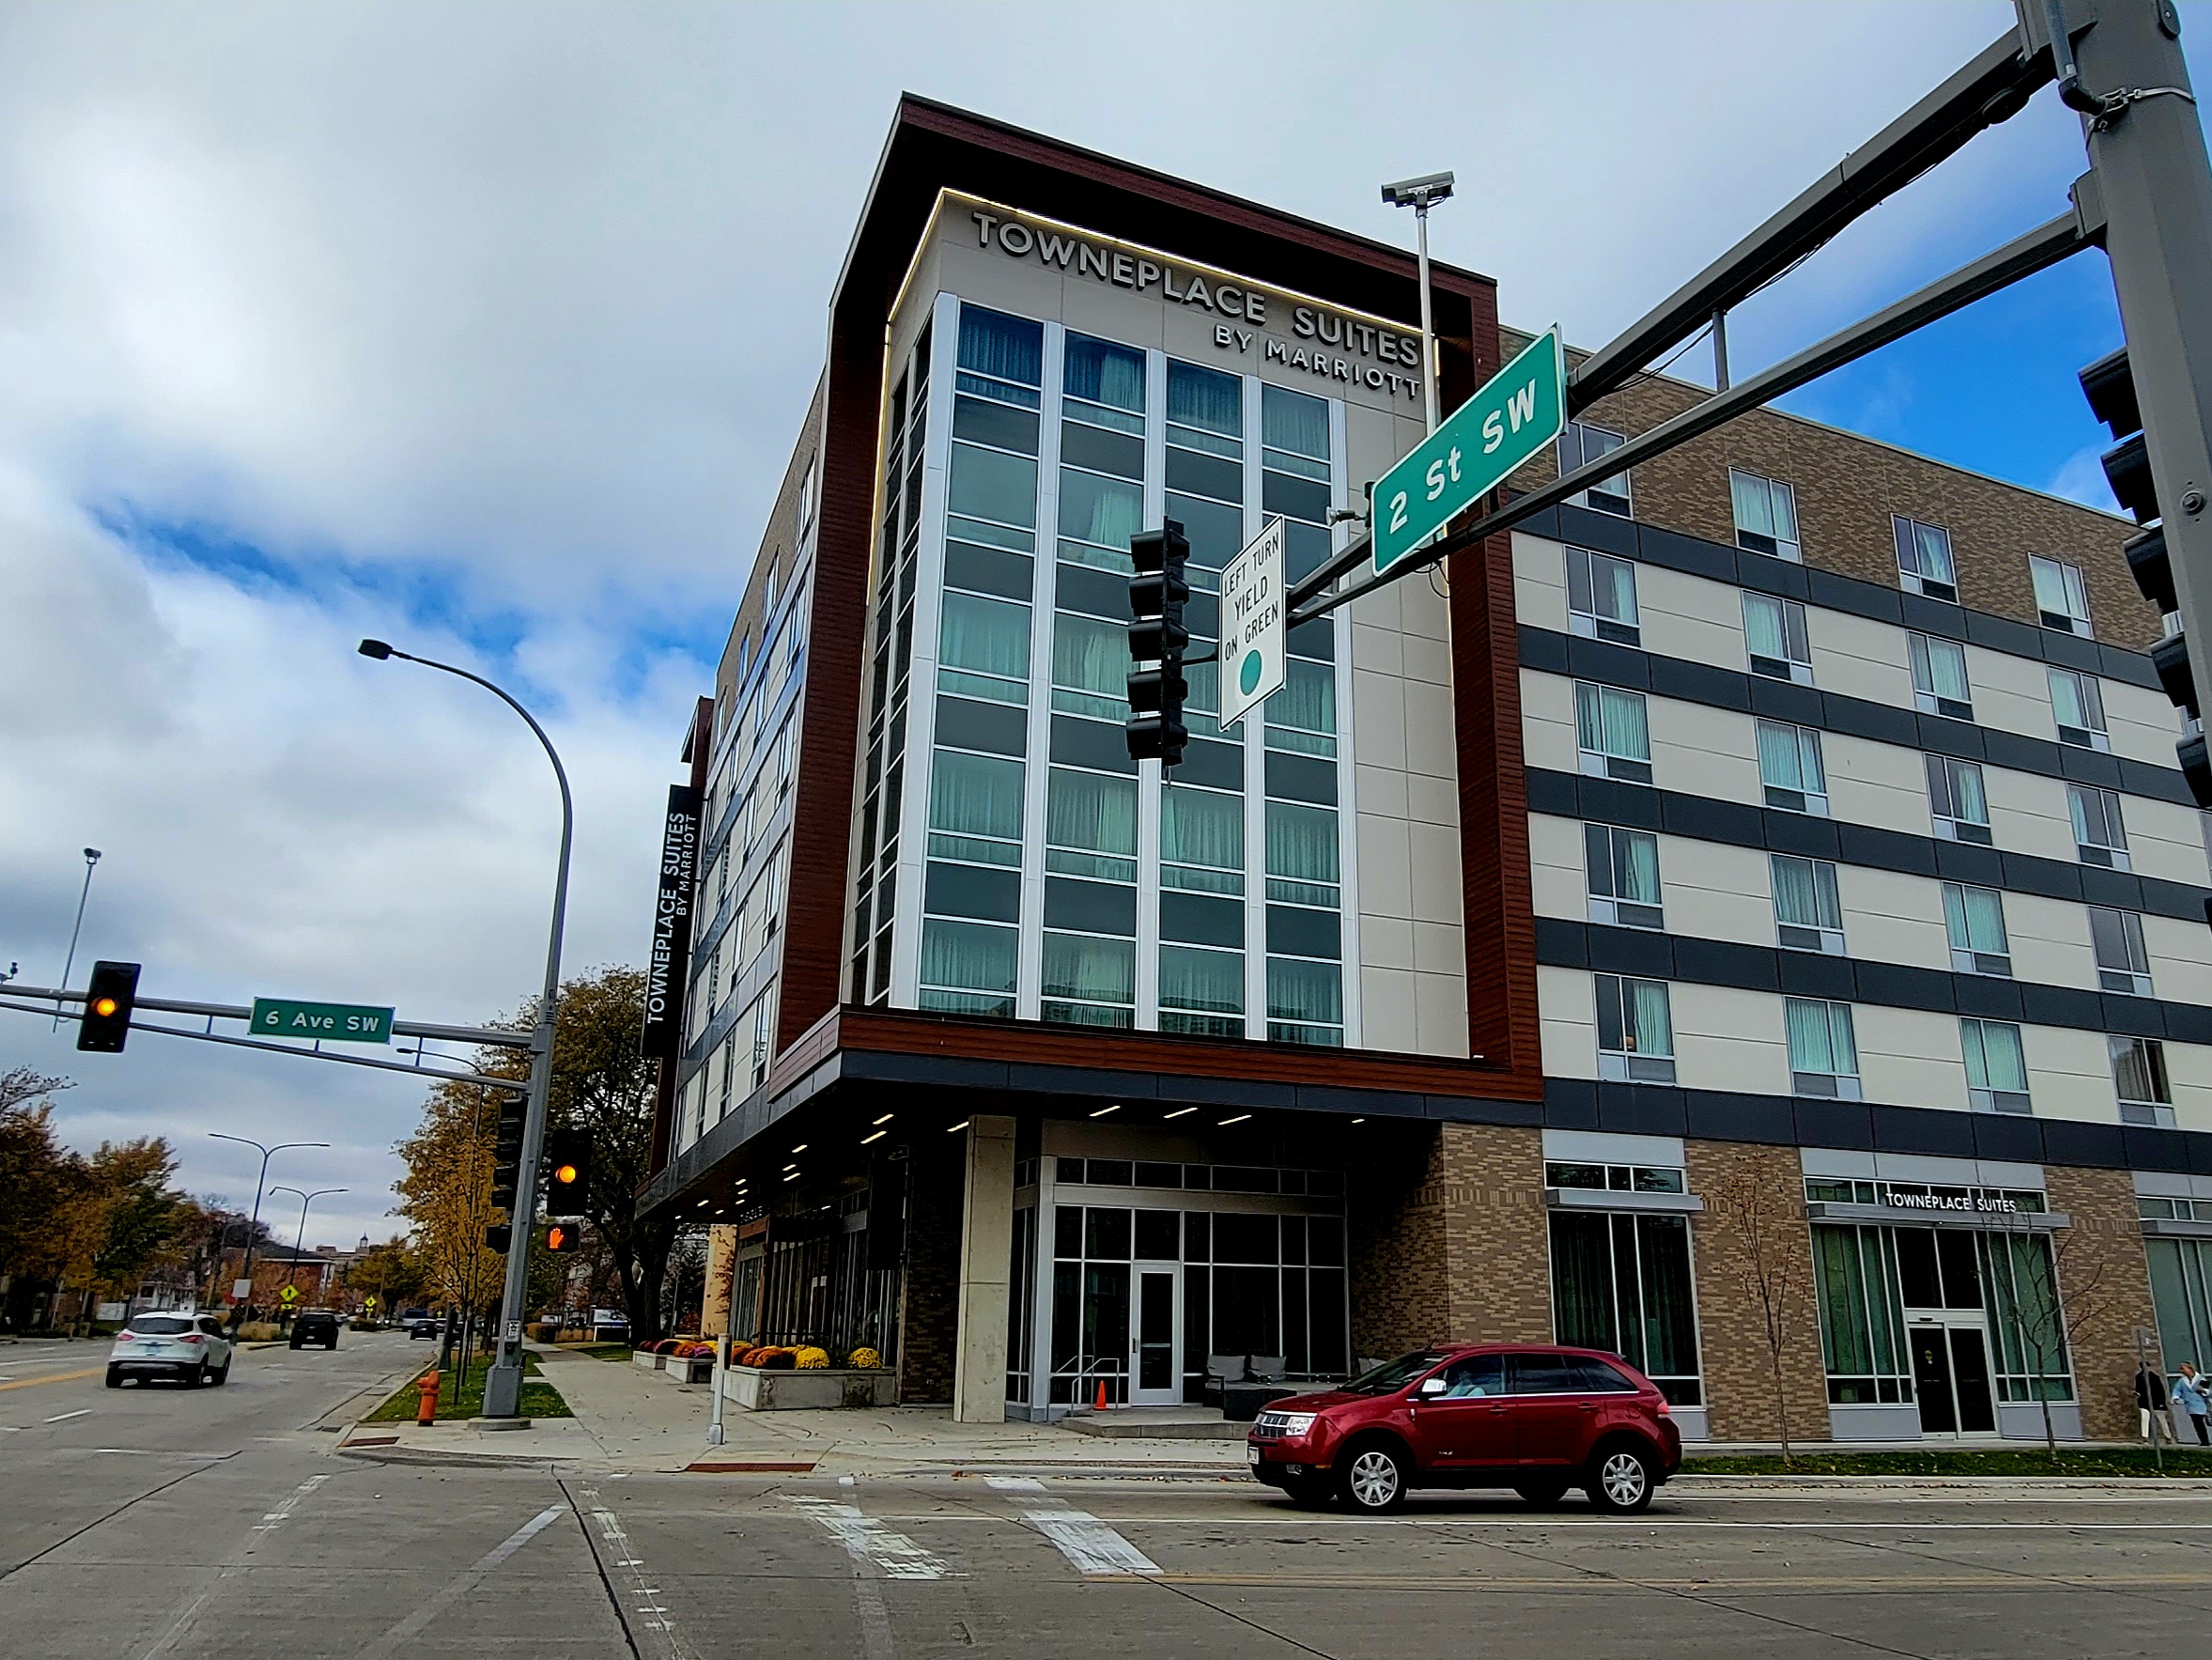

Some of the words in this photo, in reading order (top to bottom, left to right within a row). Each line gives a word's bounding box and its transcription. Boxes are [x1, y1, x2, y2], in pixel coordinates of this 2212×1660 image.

[972, 211, 1267, 323] TOWNEPLACE
[1293, 307, 1420, 367] SUITES
[1215, 324, 1253, 352] BY
[1267, 339, 1420, 399] MARRIOTT
[1389, 490, 1408, 534] 2
[1426, 446, 1462, 501] St
[1482, 378, 1536, 454] SW
[1225, 562, 1246, 597] LEFT
[1252, 532, 1279, 571] TURN
[1234, 575, 1268, 621] YIELD
[1225, 635, 1238, 661] ON
[1245, 601, 1279, 644] GREEN
[679, 814, 696, 892] MARRIOTT
[647, 888, 677, 1023] TOWNEPLACE
[663, 813, 685, 876] SUITES
[676, 897, 688, 916] BY
[265, 1011, 279, 1025] 6
[292, 1012, 334, 1029] Ave
[347, 1016, 379, 1032] SW
[1886, 1193, 1970, 1210] TOWNEPLACE
[1977, 1198, 2017, 1213] SUITES
